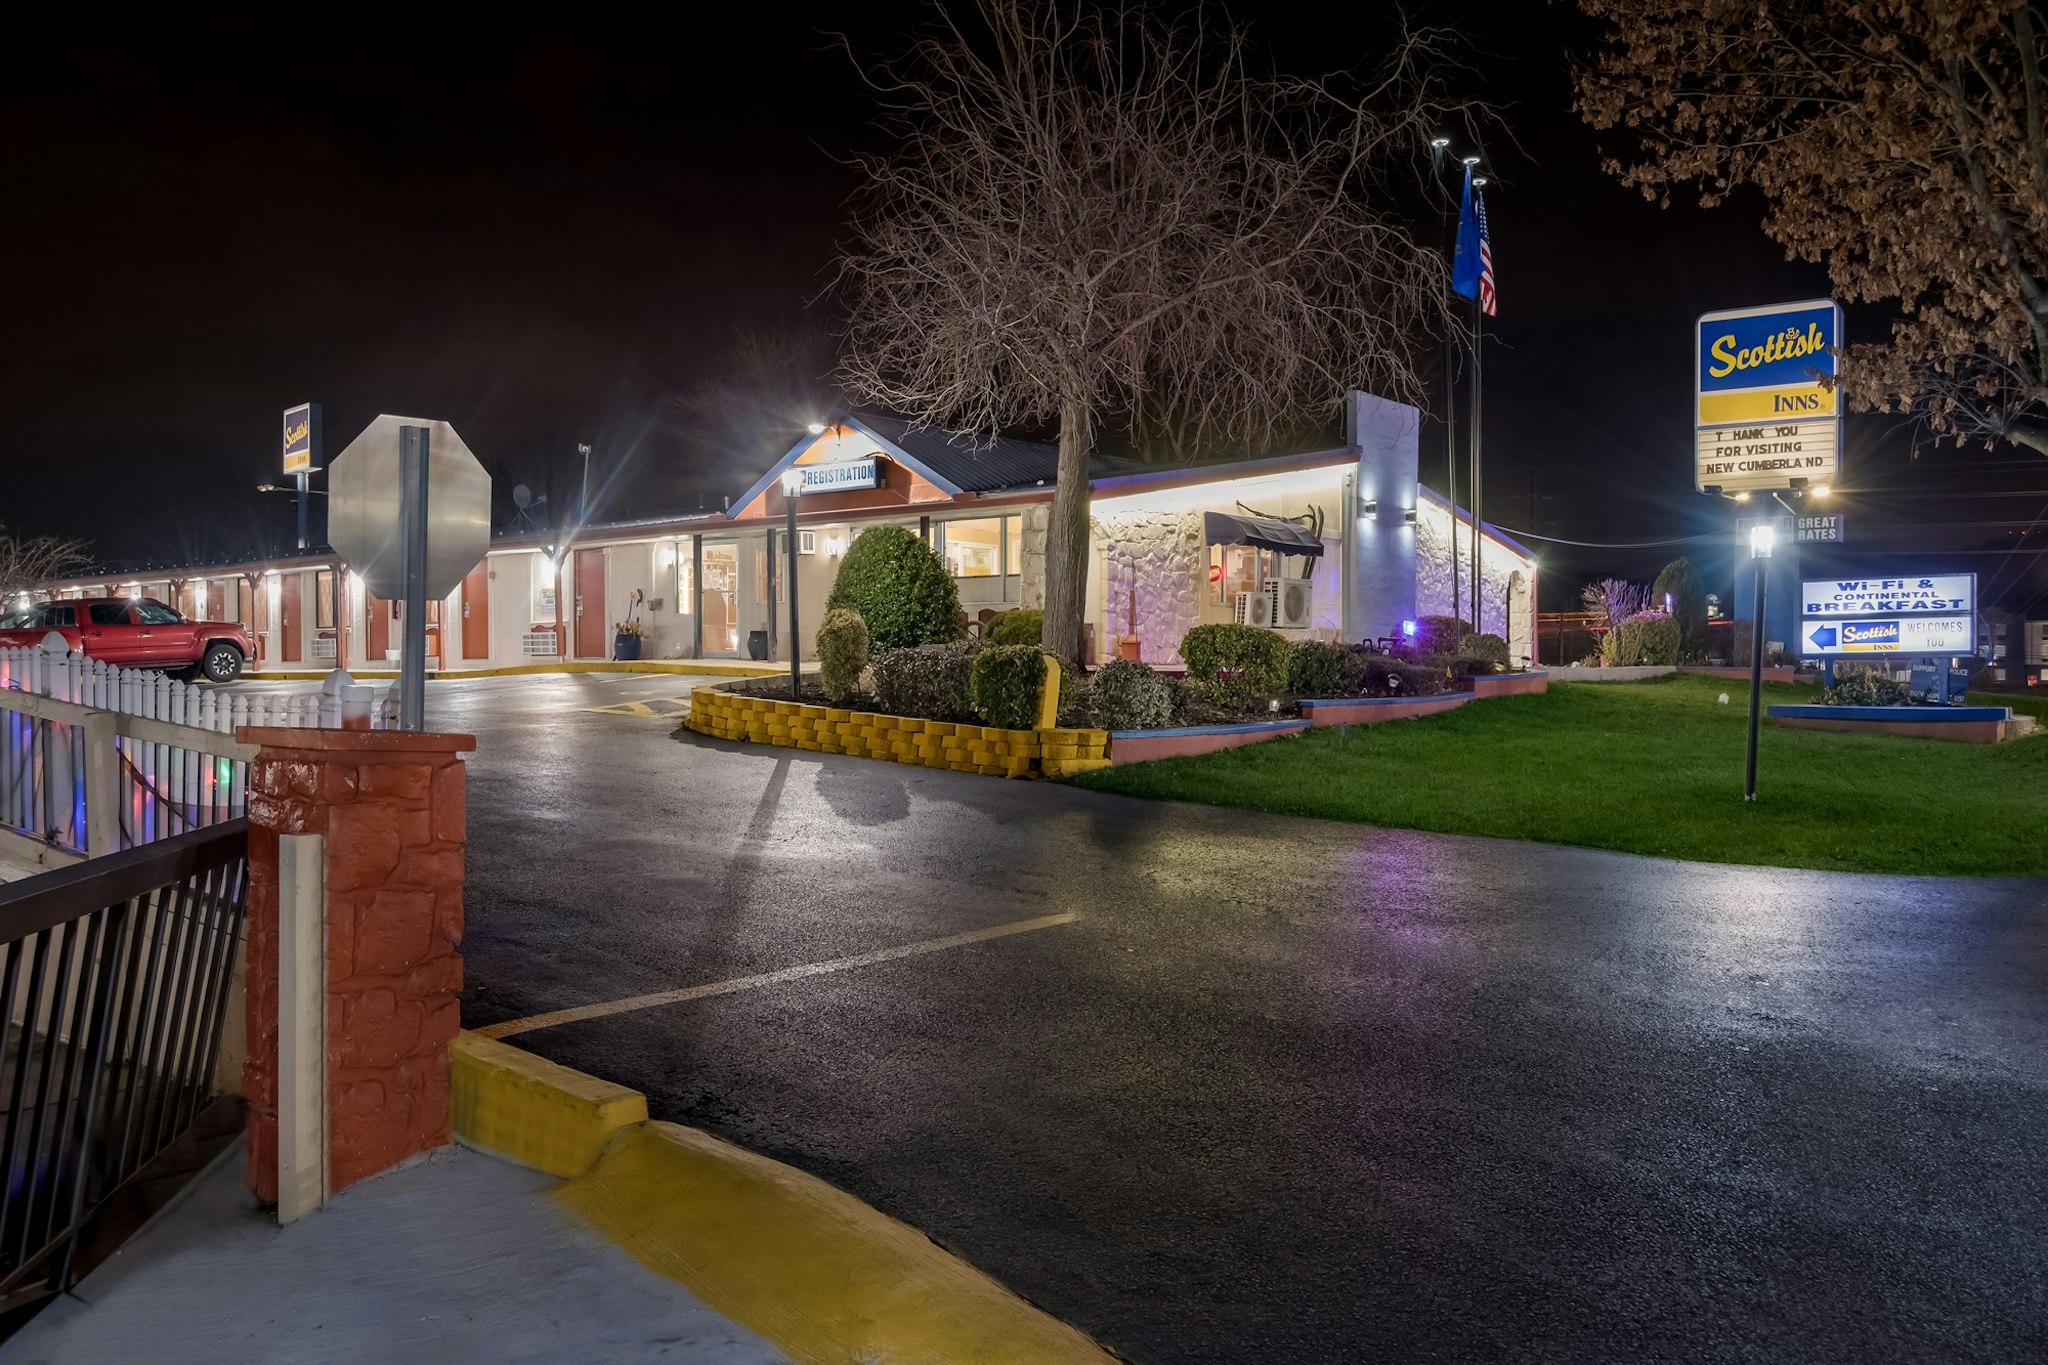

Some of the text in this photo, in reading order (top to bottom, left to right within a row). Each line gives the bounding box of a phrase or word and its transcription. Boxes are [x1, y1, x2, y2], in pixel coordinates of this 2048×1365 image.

[1708, 321, 1825, 378] Scottish
[1773, 394, 1819, 412] INNS
[1775, 426, 1798, 437] YOU
[1715, 441, 1802, 457] FOR VISITING
[1706, 461, 1734, 474] NEW
[807, 464, 874, 485] REGISTRATION
[1798, 516, 1836, 528] GREAT
[1798, 528, 1836, 540] RATES
[1917, 579, 1934, 589] &
[1833, 591, 1939, 601] CONTINENTAL
[1807, 599, 1964, 613] BREAKFAST
[1843, 624, 1898, 643] Scottish
[1906, 621, 1963, 633] WELCOMES
[1925, 637, 1944, 647] YOU
[1912, 663, 1968, 677] SUPPORT POLICE
